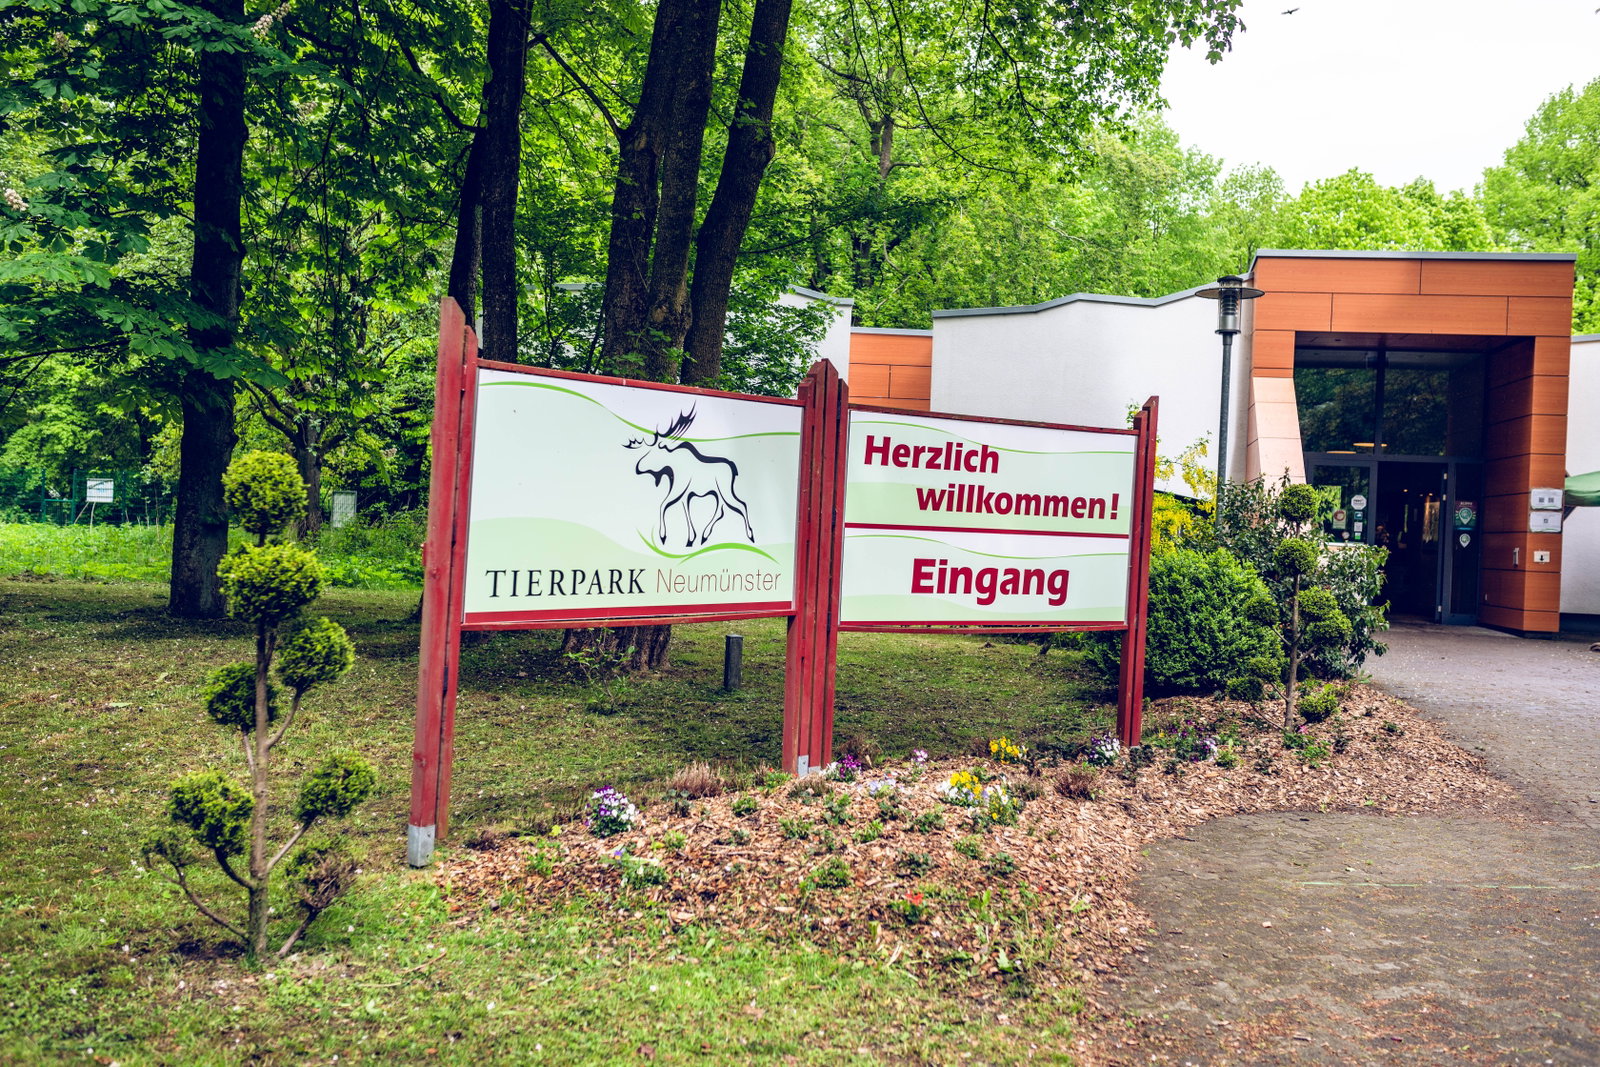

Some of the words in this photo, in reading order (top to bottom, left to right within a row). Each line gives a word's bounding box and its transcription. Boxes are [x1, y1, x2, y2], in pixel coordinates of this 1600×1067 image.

[864, 435, 1000, 474] Herzlich
[916, 483, 1120, 520] willkommen!
[485, 568, 646, 598] TIERPARK
[656, 568, 782, 594] Neumünster
[911, 558, 1070, 606] Eingang
